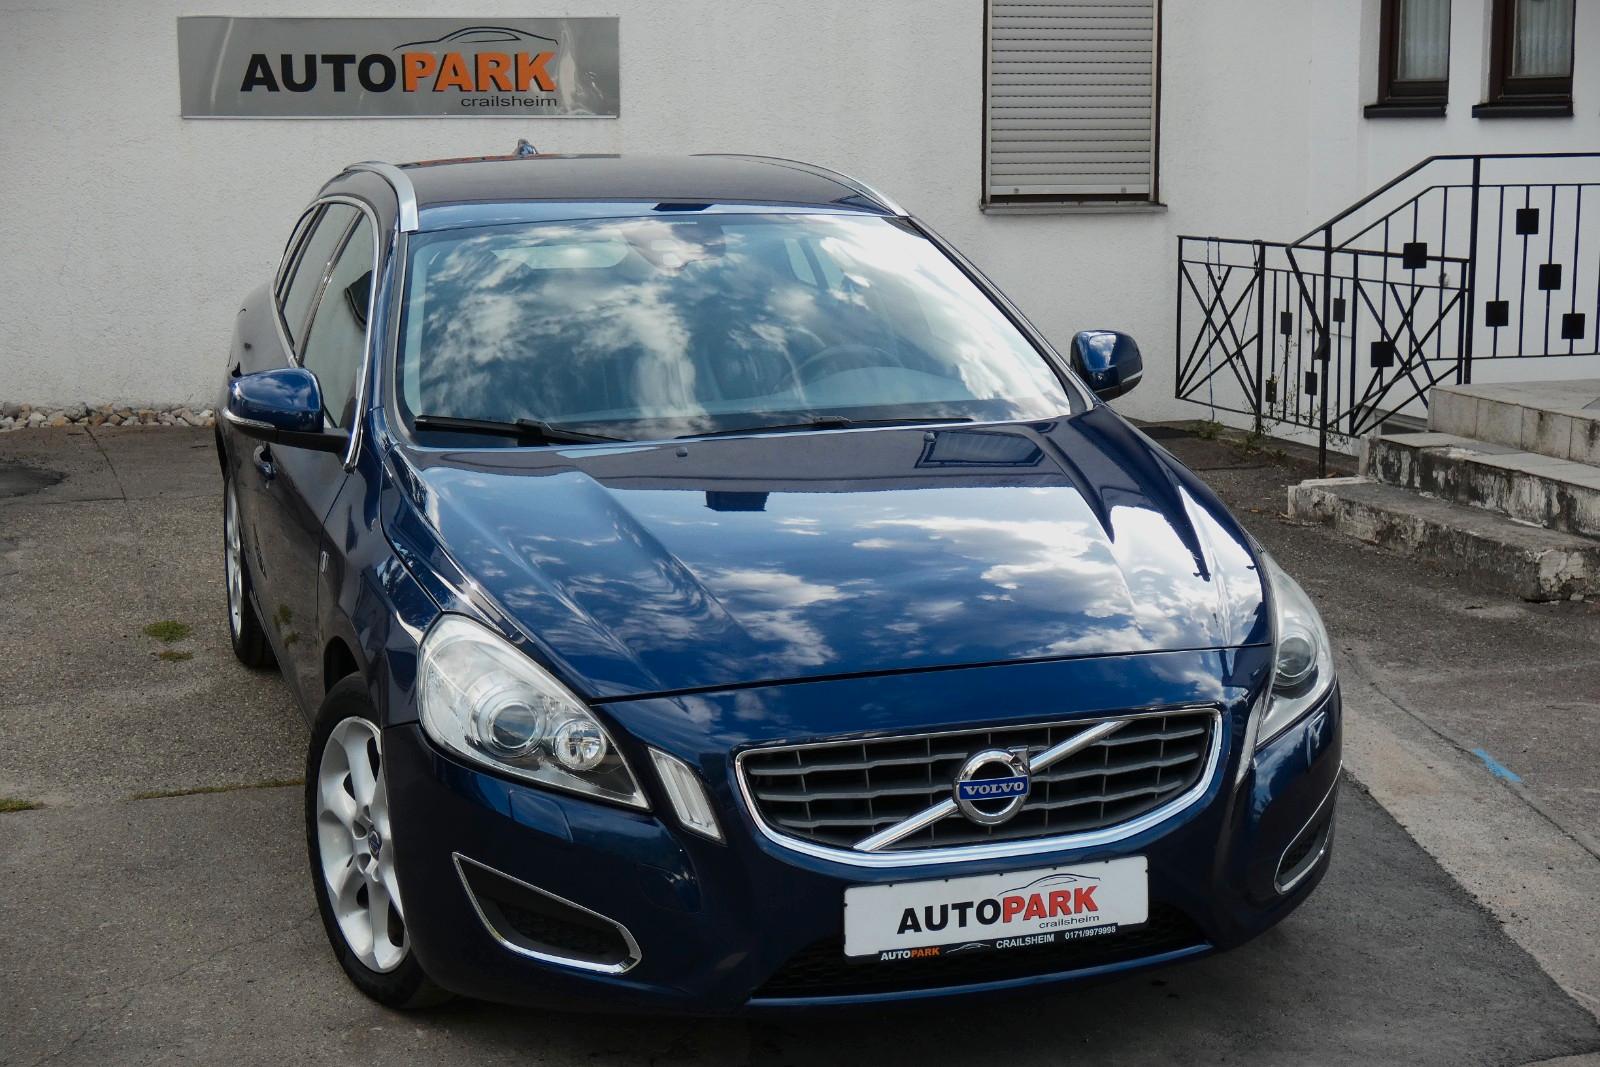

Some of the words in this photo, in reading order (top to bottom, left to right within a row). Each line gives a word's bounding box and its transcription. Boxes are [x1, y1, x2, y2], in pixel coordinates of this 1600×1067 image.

[240, 52, 558, 93] AUTOPARK
[460, 95, 557, 107] crailsheim
[963, 782, 1025, 796] VOLVO
[897, 885, 1098, 935] AUTOPARK
[1038, 914, 1100, 929] crailsheim
[880, 947, 940, 961] AUTOPARK
[995, 933, 1055, 949] CRAILSHEIM
[1064, 925, 1117, 940] 0171/9979998
